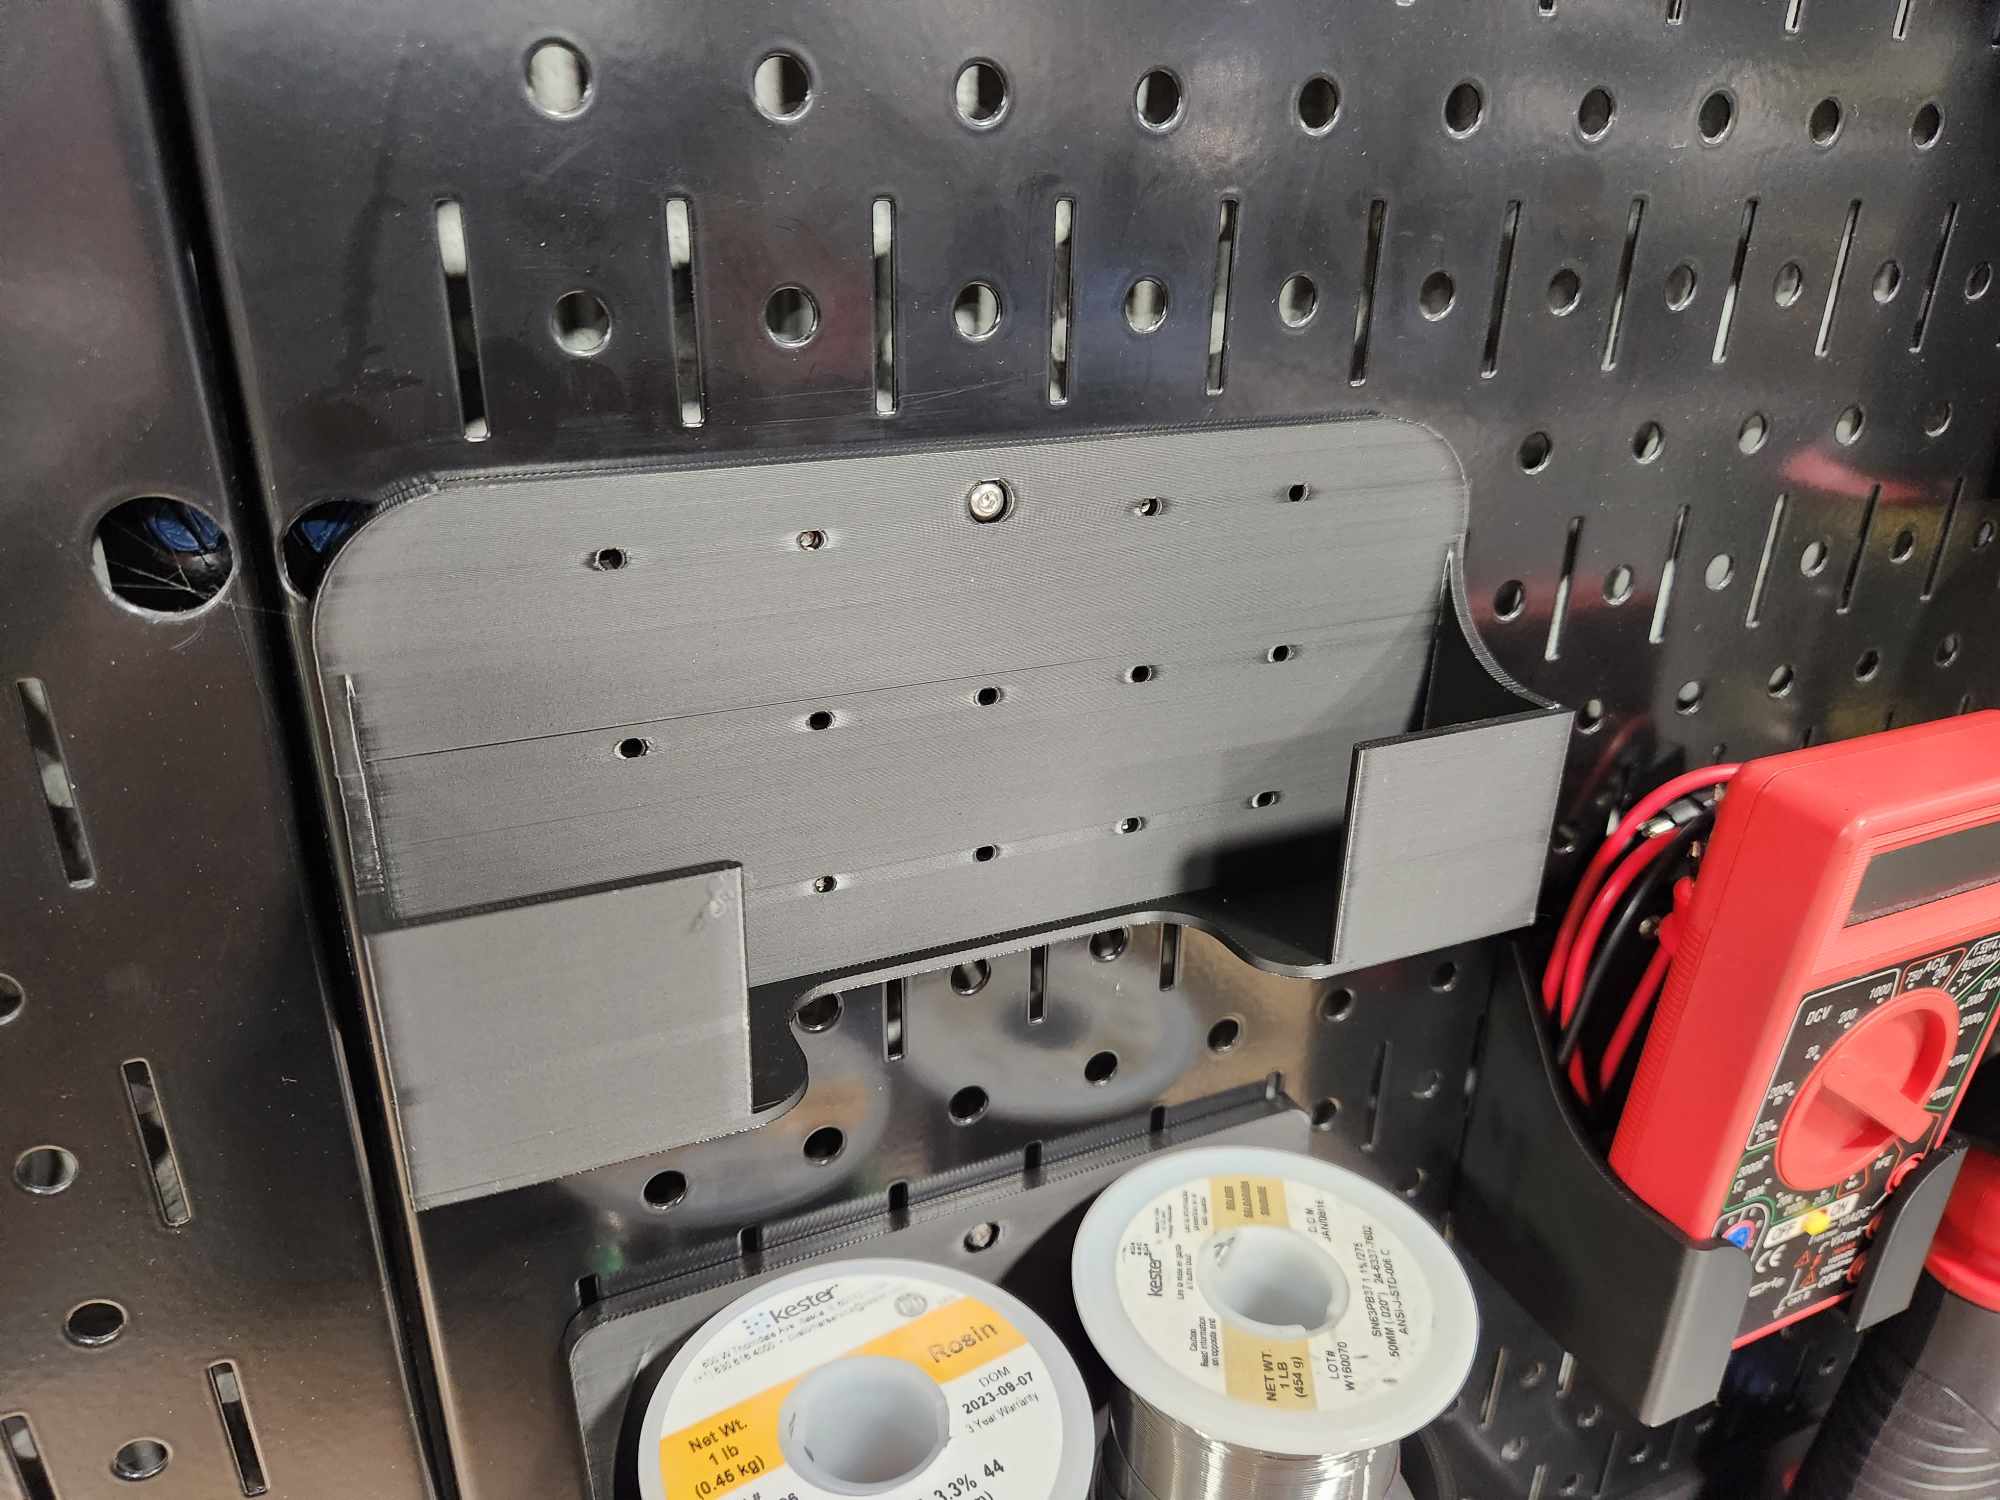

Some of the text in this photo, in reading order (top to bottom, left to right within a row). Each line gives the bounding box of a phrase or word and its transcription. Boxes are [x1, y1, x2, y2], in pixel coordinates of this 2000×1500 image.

[1924, 955, 1949, 973] ACV
[1869, 982, 1893, 1000] 1000
[1804, 1004, 1833, 1026] DCV
[1837, 1008, 1858, 1024] 200
[1755, 1243, 1788, 1273] CE
[1147, 1255, 1163, 1297] kester
[769, 1285, 837, 1324] kester
[928, 1323, 998, 1363] Rosin
[978, 1366, 1011, 1388] DOM
[1277, 1361, 1289, 1379] LB
[1290, 1356, 1308, 1398] (454 g)
[1325, 1349, 1340, 1380] LOT#
[1337, 1341, 1355, 1391] W160070
[1264, 1375, 1277, 1401] NET
[688, 1418, 748, 1453] Net Wt.
[708, 1444, 740, 1466] 1 lb
[983, 1458, 1004, 1477] 44
[695, 1455, 765, 1500] (0.45 kg)
